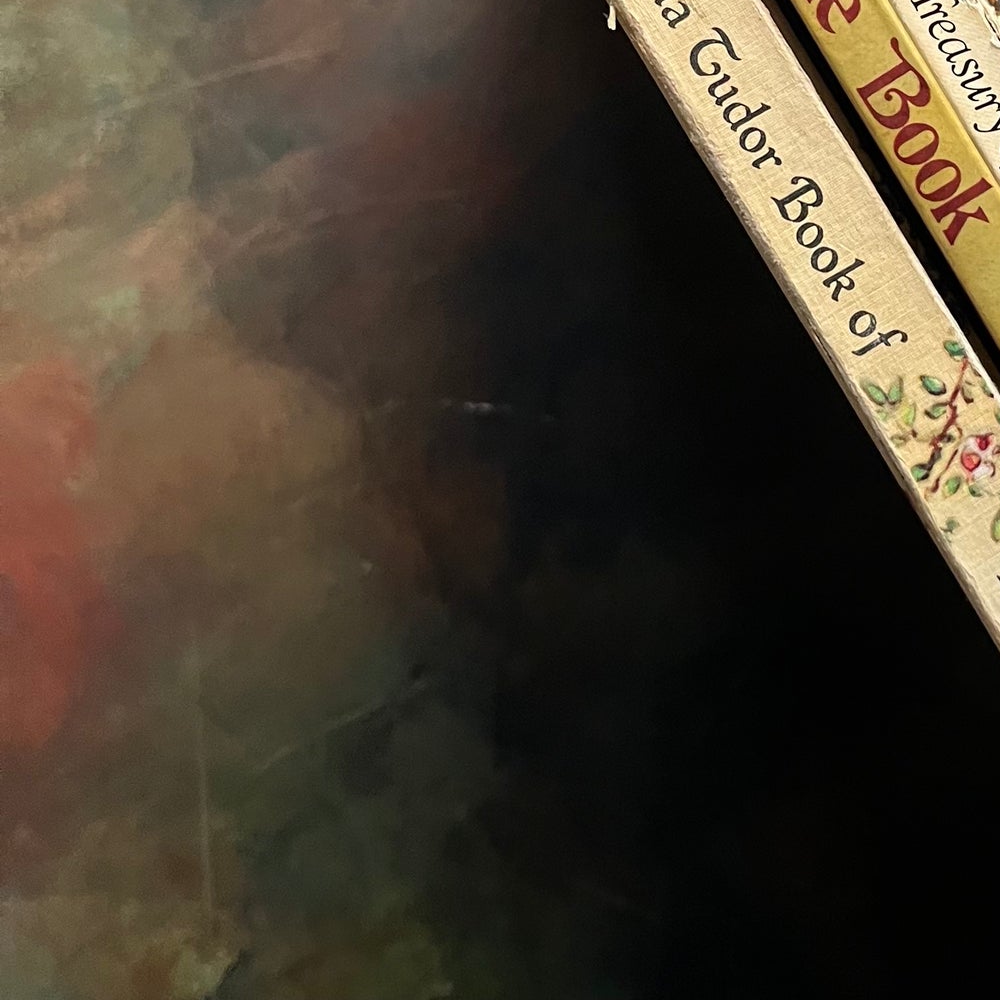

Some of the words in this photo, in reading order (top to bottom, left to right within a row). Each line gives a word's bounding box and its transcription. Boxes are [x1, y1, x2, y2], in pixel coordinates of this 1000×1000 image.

[689, 26, 783, 170] Tudor
[770, 175, 866, 303] Book
[848, 309, 908, 357] of
[856, 37, 994, 246] Book
